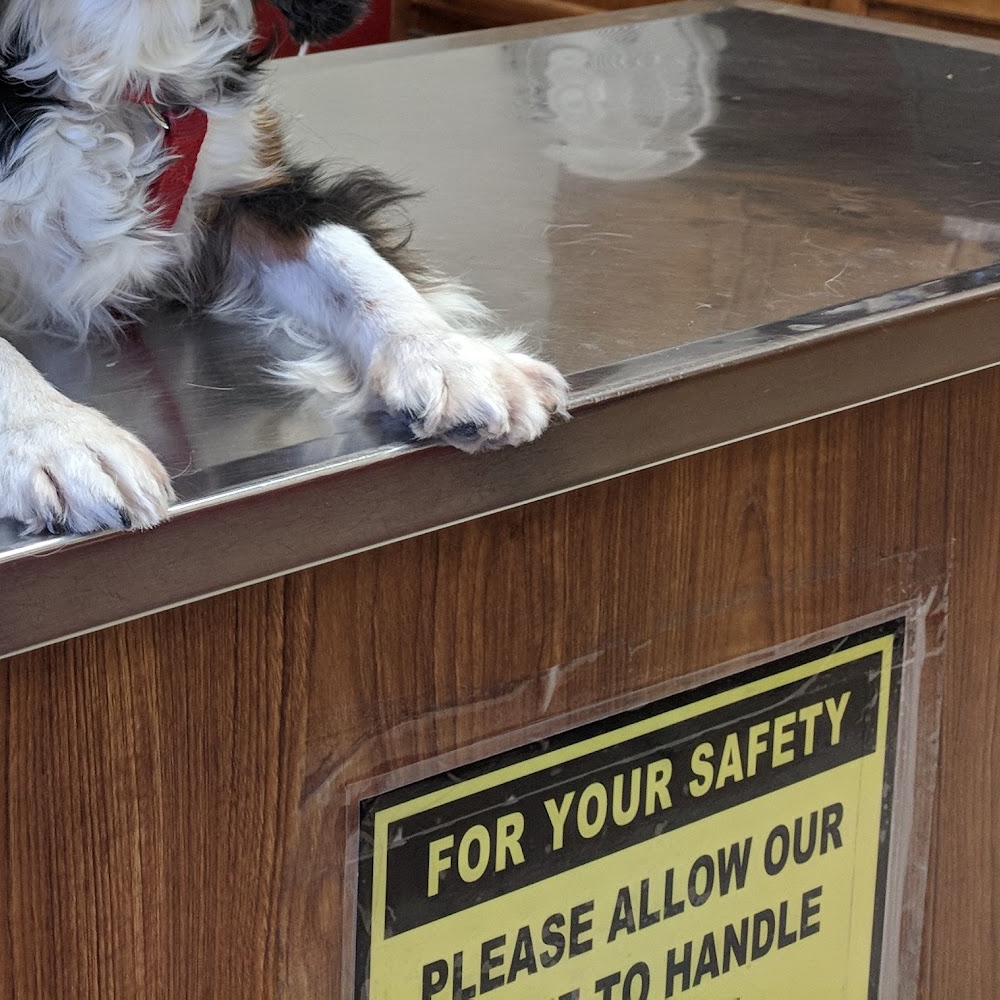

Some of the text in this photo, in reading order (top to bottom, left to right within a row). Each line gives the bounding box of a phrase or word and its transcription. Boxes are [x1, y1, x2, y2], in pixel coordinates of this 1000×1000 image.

[427, 691, 852, 897] FOR YOUR SAFETY
[421, 802, 844, 1000] PLEASE ALLOW OUR
[595, 885, 823, 1000] TO HANDLE
